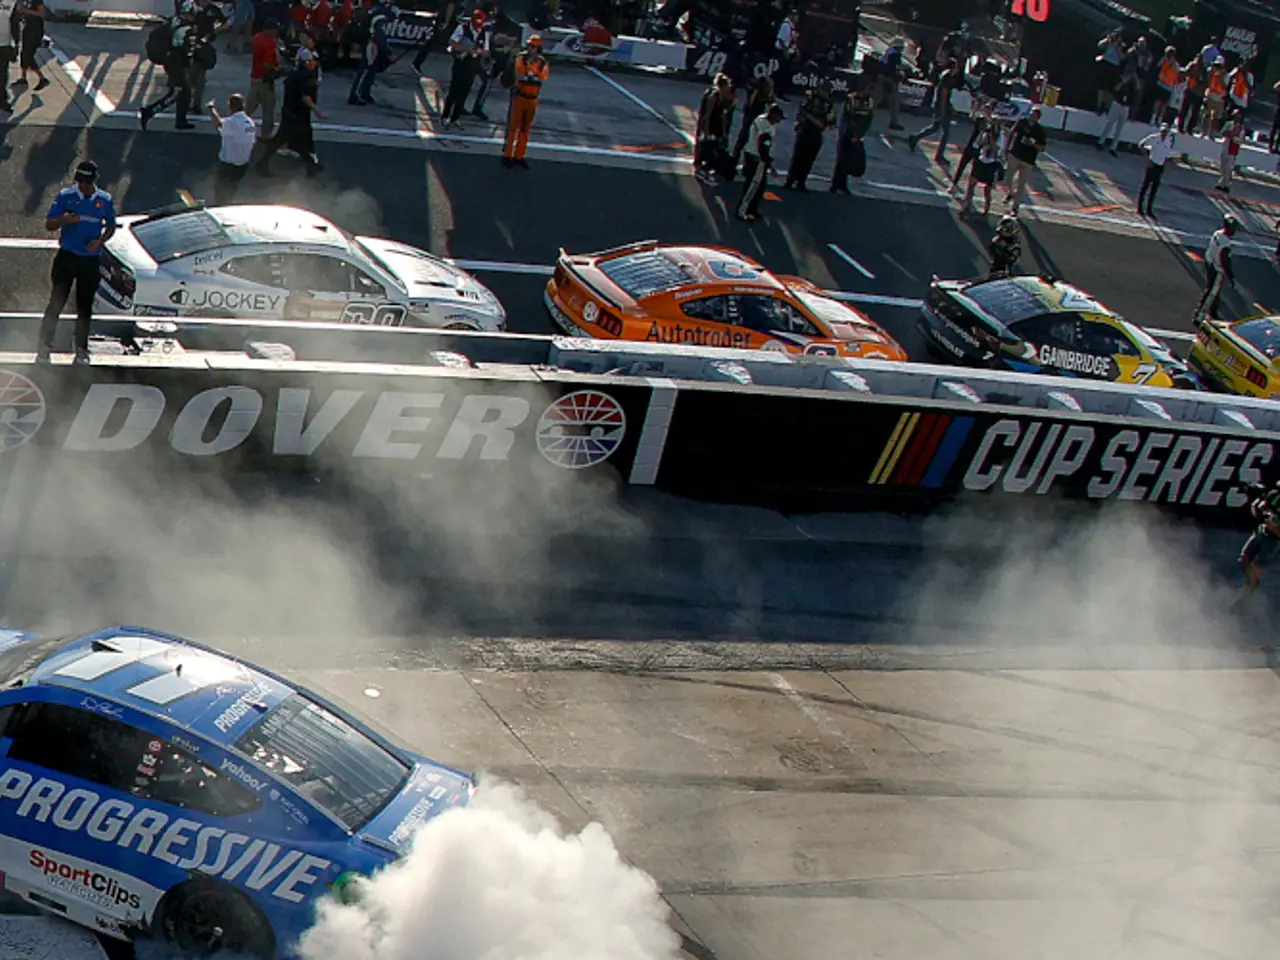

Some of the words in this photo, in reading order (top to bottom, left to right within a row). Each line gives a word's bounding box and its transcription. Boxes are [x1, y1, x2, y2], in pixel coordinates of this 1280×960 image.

[694, 52, 728, 77] 48
[192, 291, 280, 310] JOCKEY
[646, 320, 752, 348] Autotrader
[1040, 344, 1111, 377] GAINBRIDGE
[61, 383, 530, 461] DOVER
[963, 419, 1096, 494] CUP
[1087, 431, 1273, 507] SERIES
[220, 758, 268, 792] yahoo!
[29, 849, 141, 909] SportClips
